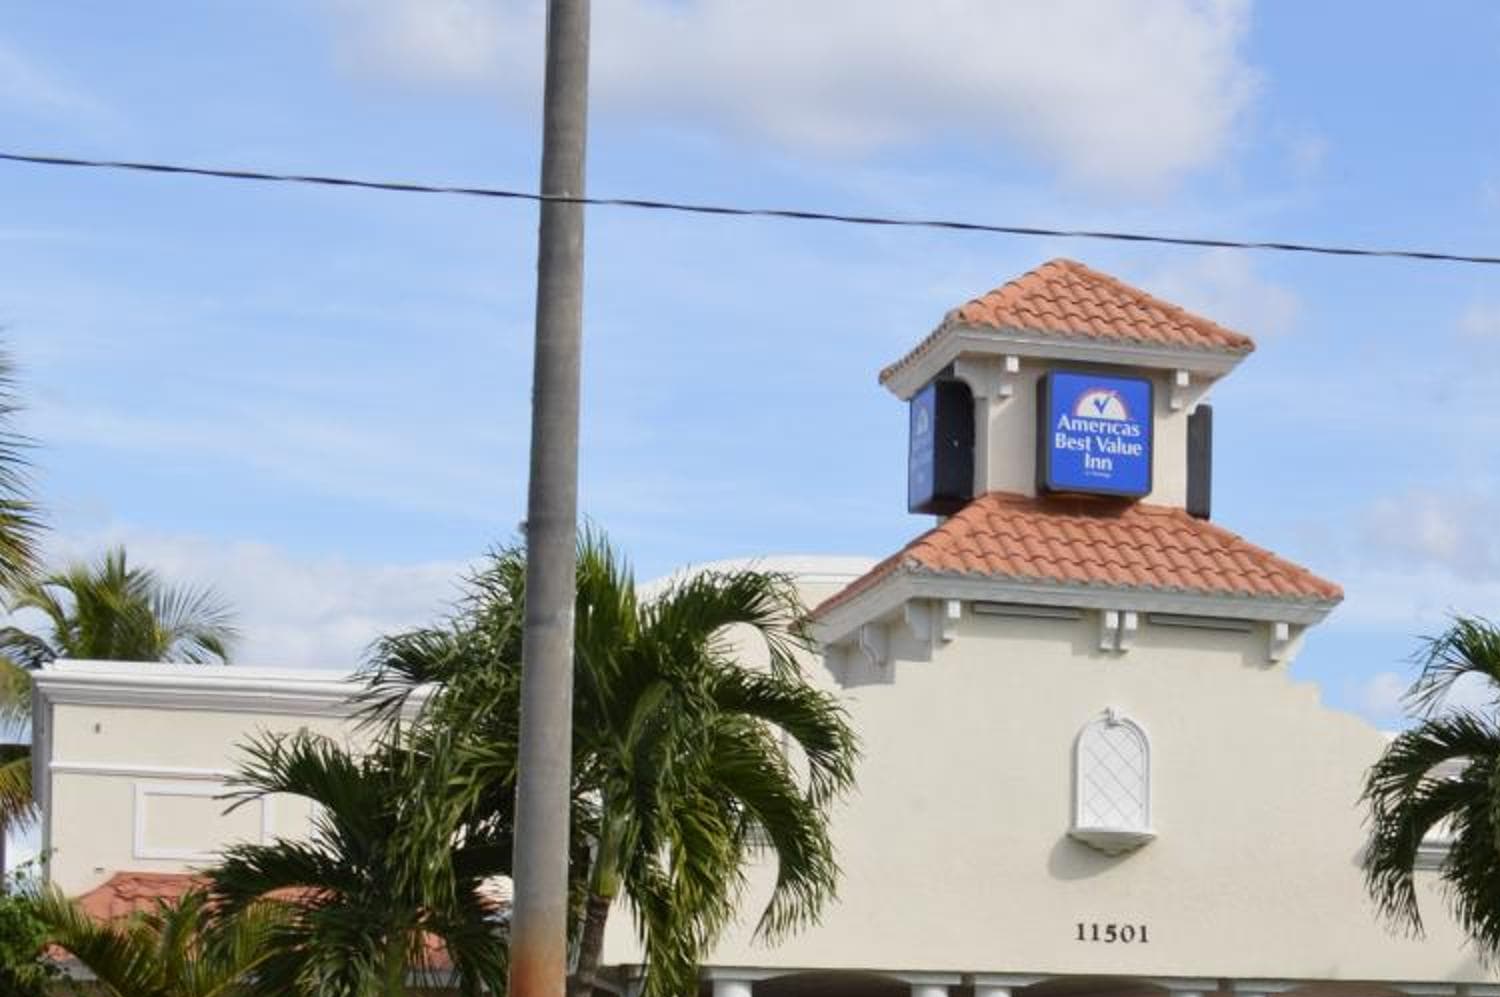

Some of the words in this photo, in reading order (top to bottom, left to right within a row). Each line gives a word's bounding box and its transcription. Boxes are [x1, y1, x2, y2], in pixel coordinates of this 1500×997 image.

[1057, 413, 1140, 437] Americas
[1055, 432, 1091, 451] Best
[1095, 435, 1142, 456] Value
[1084, 452, 1113, 471] Inn
[1074, 922, 1149, 943] 11501
